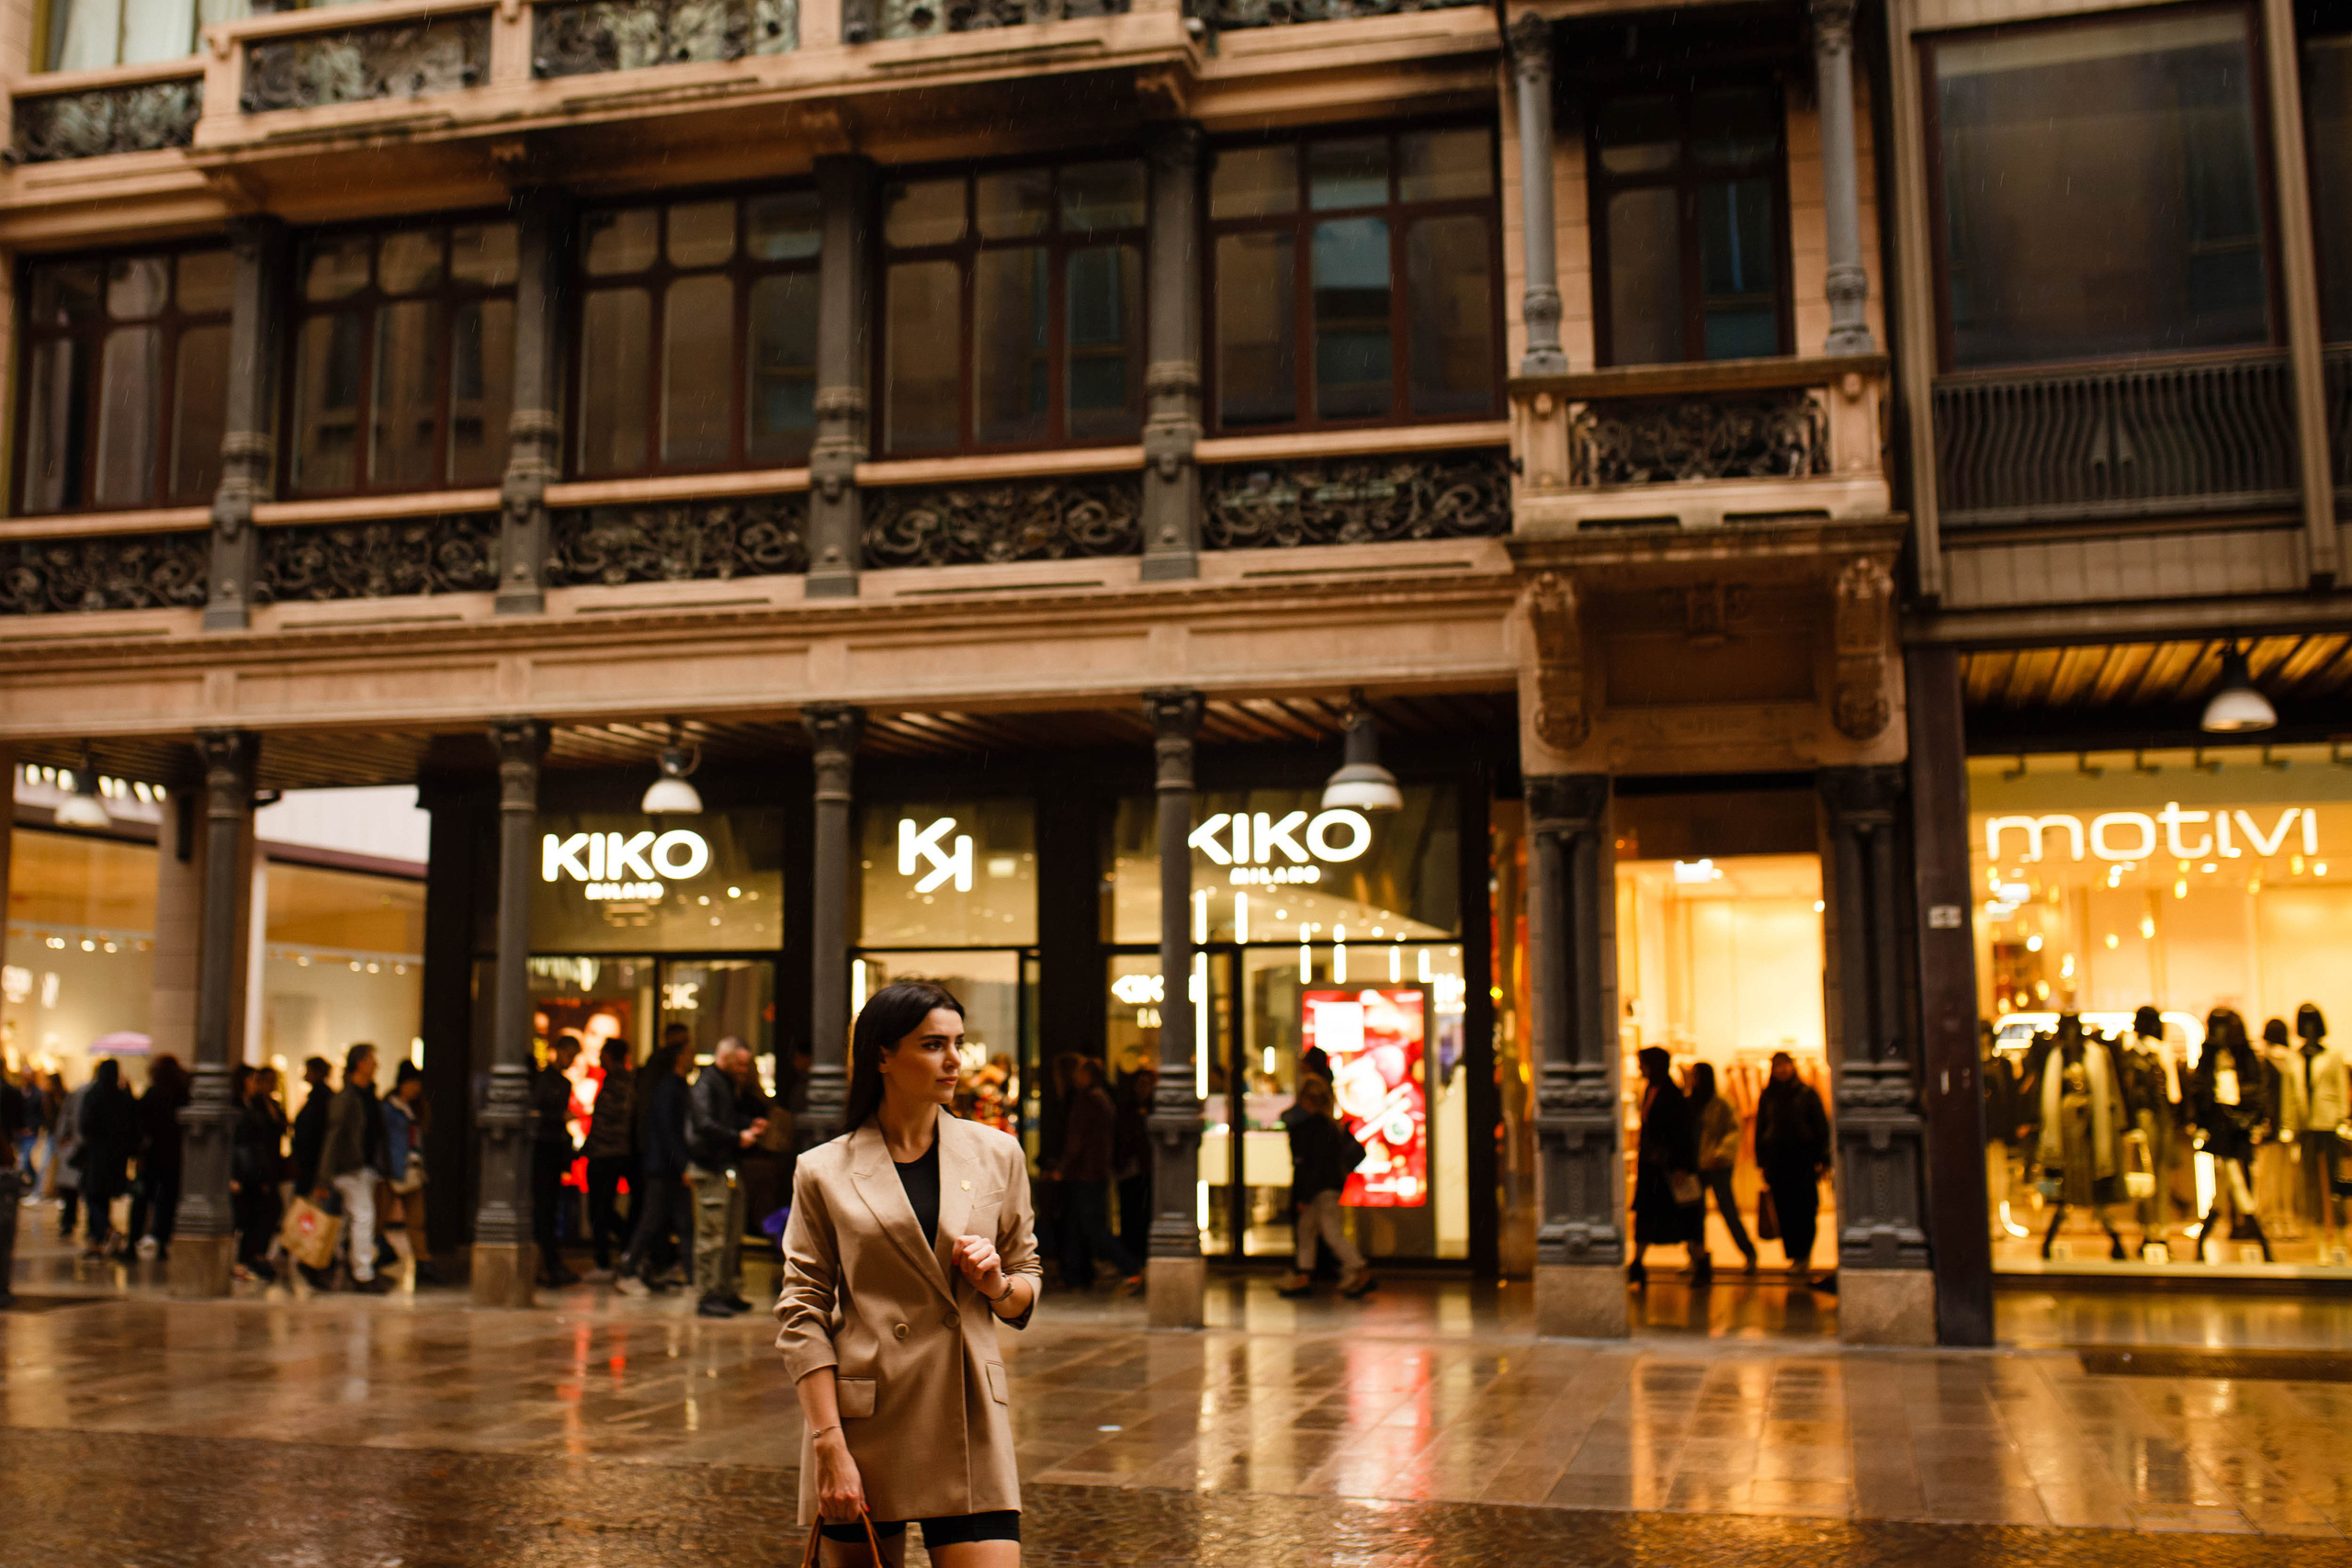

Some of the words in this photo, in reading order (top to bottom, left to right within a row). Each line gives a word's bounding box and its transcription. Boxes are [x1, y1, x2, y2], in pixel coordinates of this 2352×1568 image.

[542, 830, 708, 882] KIKO
[1188, 809, 1372, 865] KIKO
[1985, 801, 2319, 863] motivi
[1229, 865, 1320, 886] MILANO
